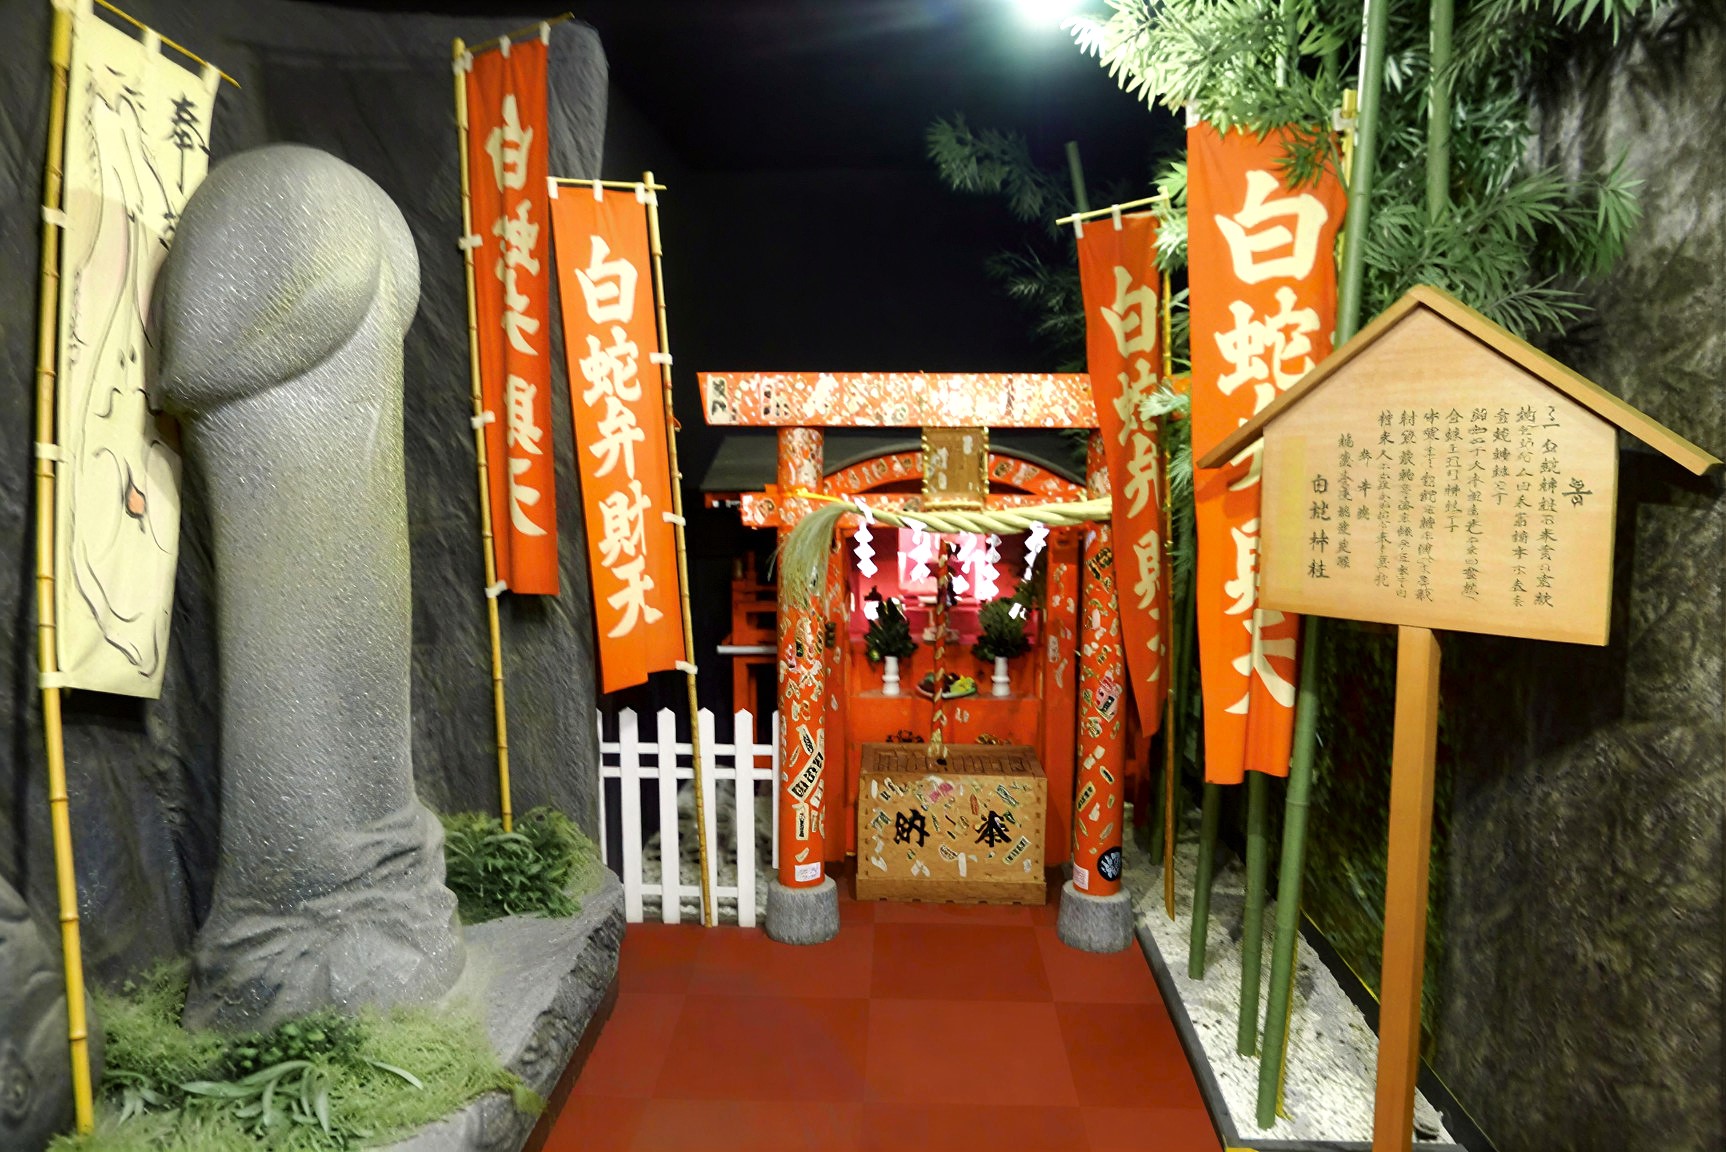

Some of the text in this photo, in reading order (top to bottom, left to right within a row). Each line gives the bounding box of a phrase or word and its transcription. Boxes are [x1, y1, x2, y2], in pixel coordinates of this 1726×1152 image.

[574, 235, 663, 638] 白蛇弁財天
